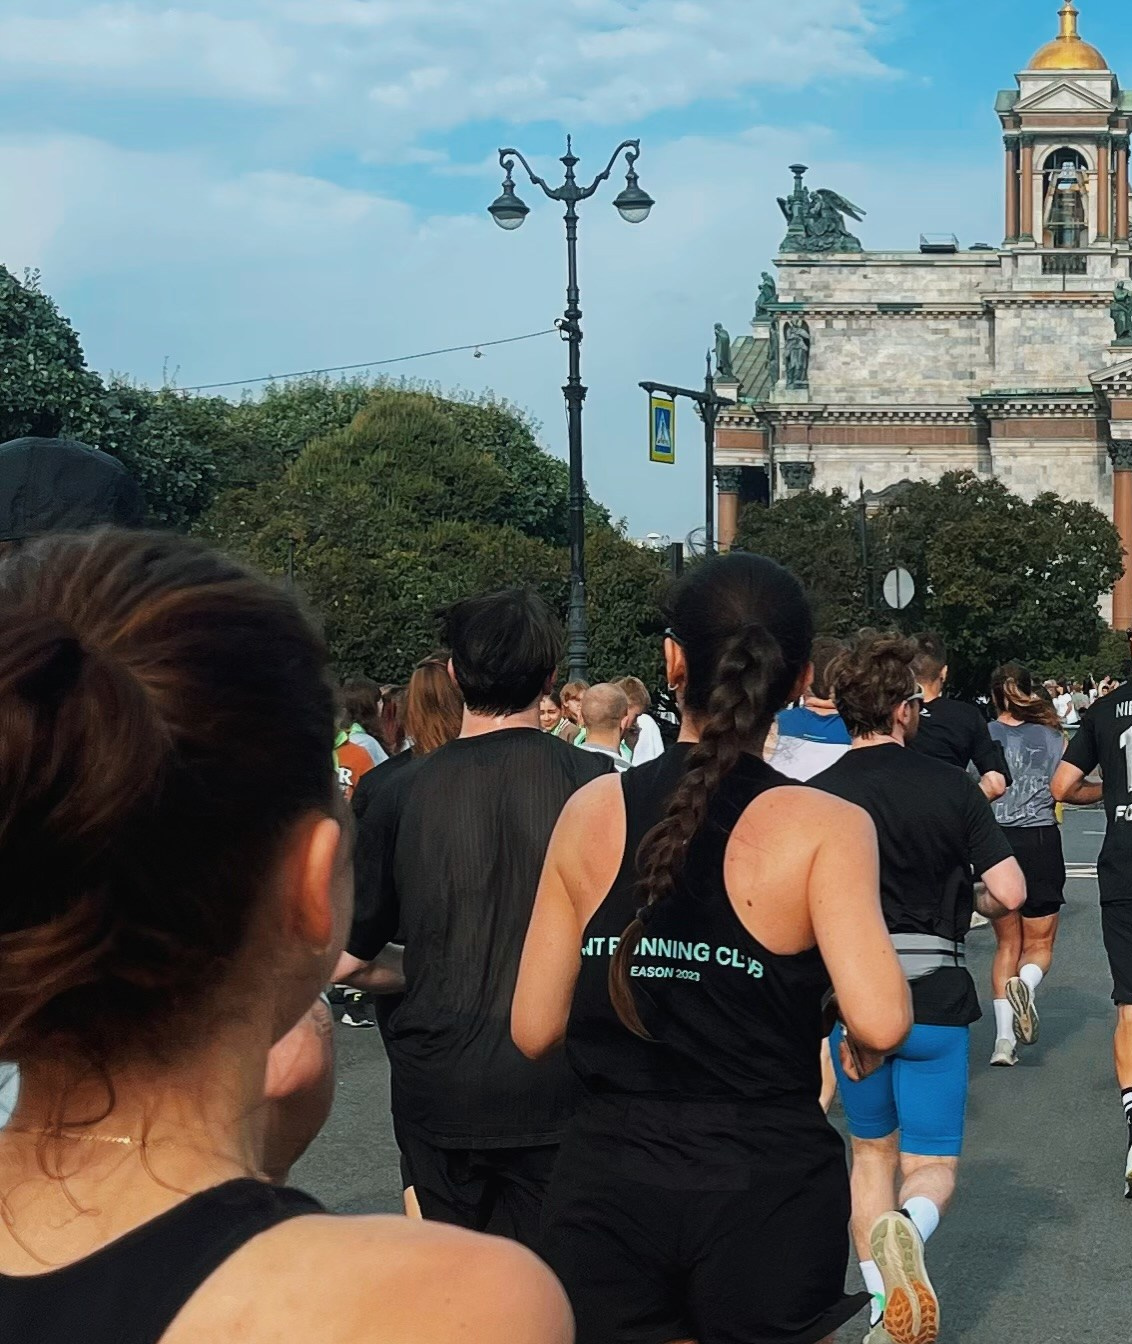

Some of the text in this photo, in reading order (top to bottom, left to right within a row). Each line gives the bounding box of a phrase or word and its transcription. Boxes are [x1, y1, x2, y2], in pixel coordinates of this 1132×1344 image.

[338, 767, 354, 786] R
[581, 937, 606, 956] NT
[608, 937, 710, 962] RNNING
[630, 965, 701, 982] EASON 2023
